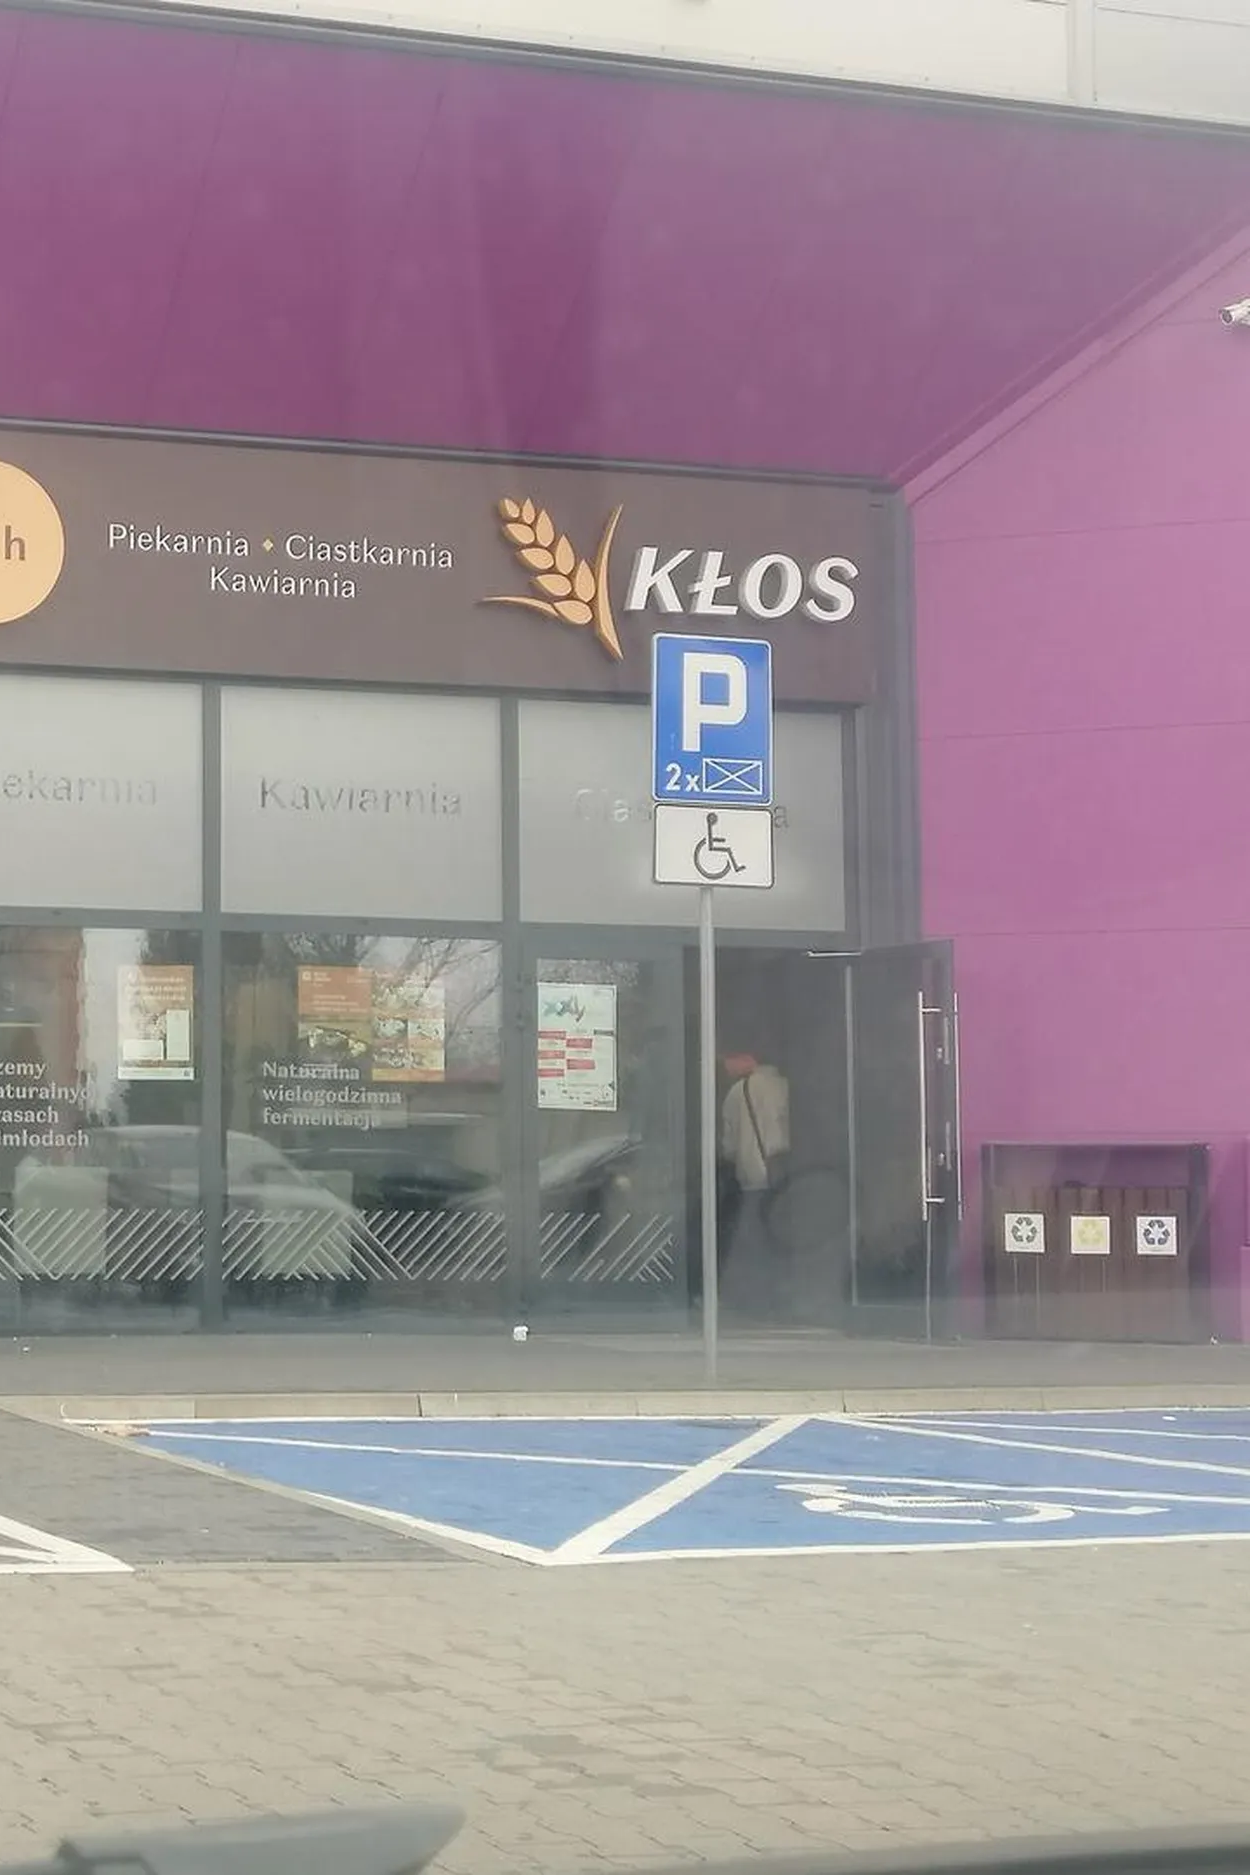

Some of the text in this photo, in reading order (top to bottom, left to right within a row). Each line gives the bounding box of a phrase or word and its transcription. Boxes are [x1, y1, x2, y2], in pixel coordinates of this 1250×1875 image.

[107, 523, 454, 569] Piekarnia Ciastkarnia
[209, 566, 357, 599] Kawiarnia
[624, 546, 860, 623] KŁOS
[681, 652, 748, 753] P
[259, 776, 461, 816] Kawiarnia
[261, 1061, 362, 1081] Naturalna
[261, 1084, 403, 1107] wielogodzinna
